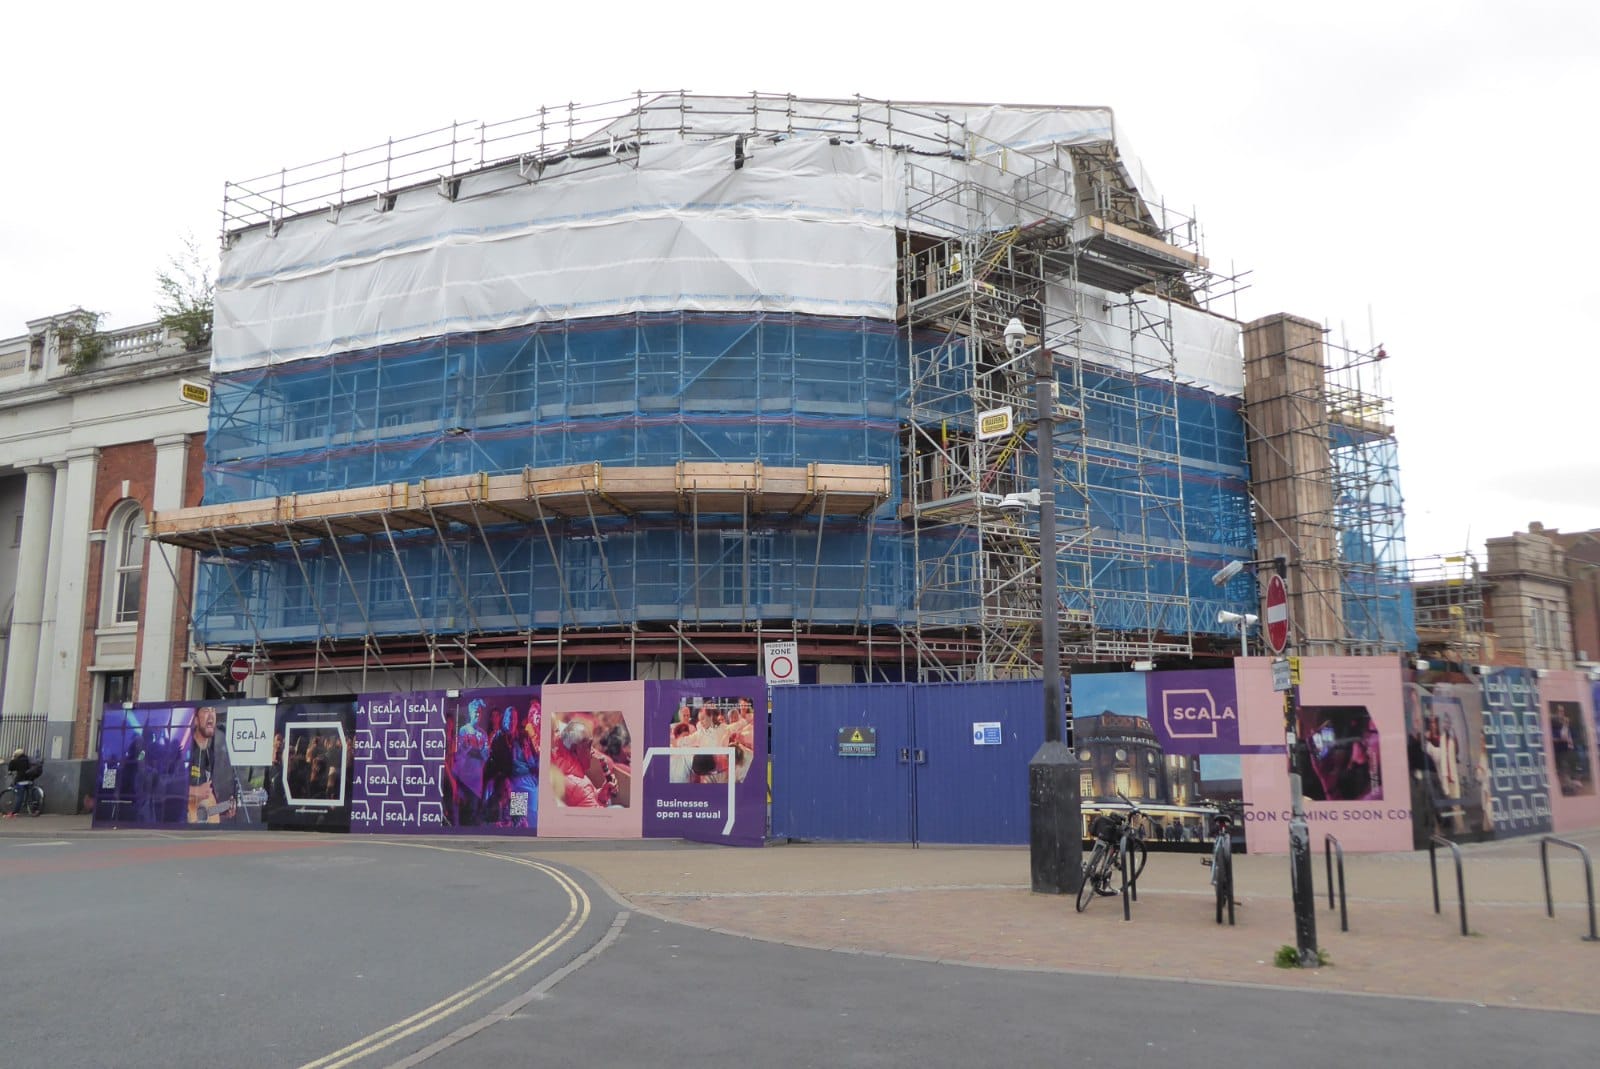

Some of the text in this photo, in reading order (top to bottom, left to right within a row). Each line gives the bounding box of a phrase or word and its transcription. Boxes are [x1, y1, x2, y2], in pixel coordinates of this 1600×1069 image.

[373, 705, 400, 713] SCALA
[409, 704, 437, 713] SCALA
[1173, 706, 1235, 720] SCALA
[236, 731, 266, 740] SCALA
[354, 741, 381, 749] SCALA
[389, 741, 417, 749] SCALA
[370, 776, 397, 784] SCALA
[406, 776, 434, 784] SCALA
[657, 799, 708, 807] Businesses
[351, 811, 377, 820] SCALA
[386, 813, 414, 821] SCALA
[656, 811, 679, 819] open
[695, 810, 720, 818] usual
[1243, 811, 1276, 821] OON
[1282, 810, 1339, 821] CMING
[1343, 810, 1382, 820] SOON
